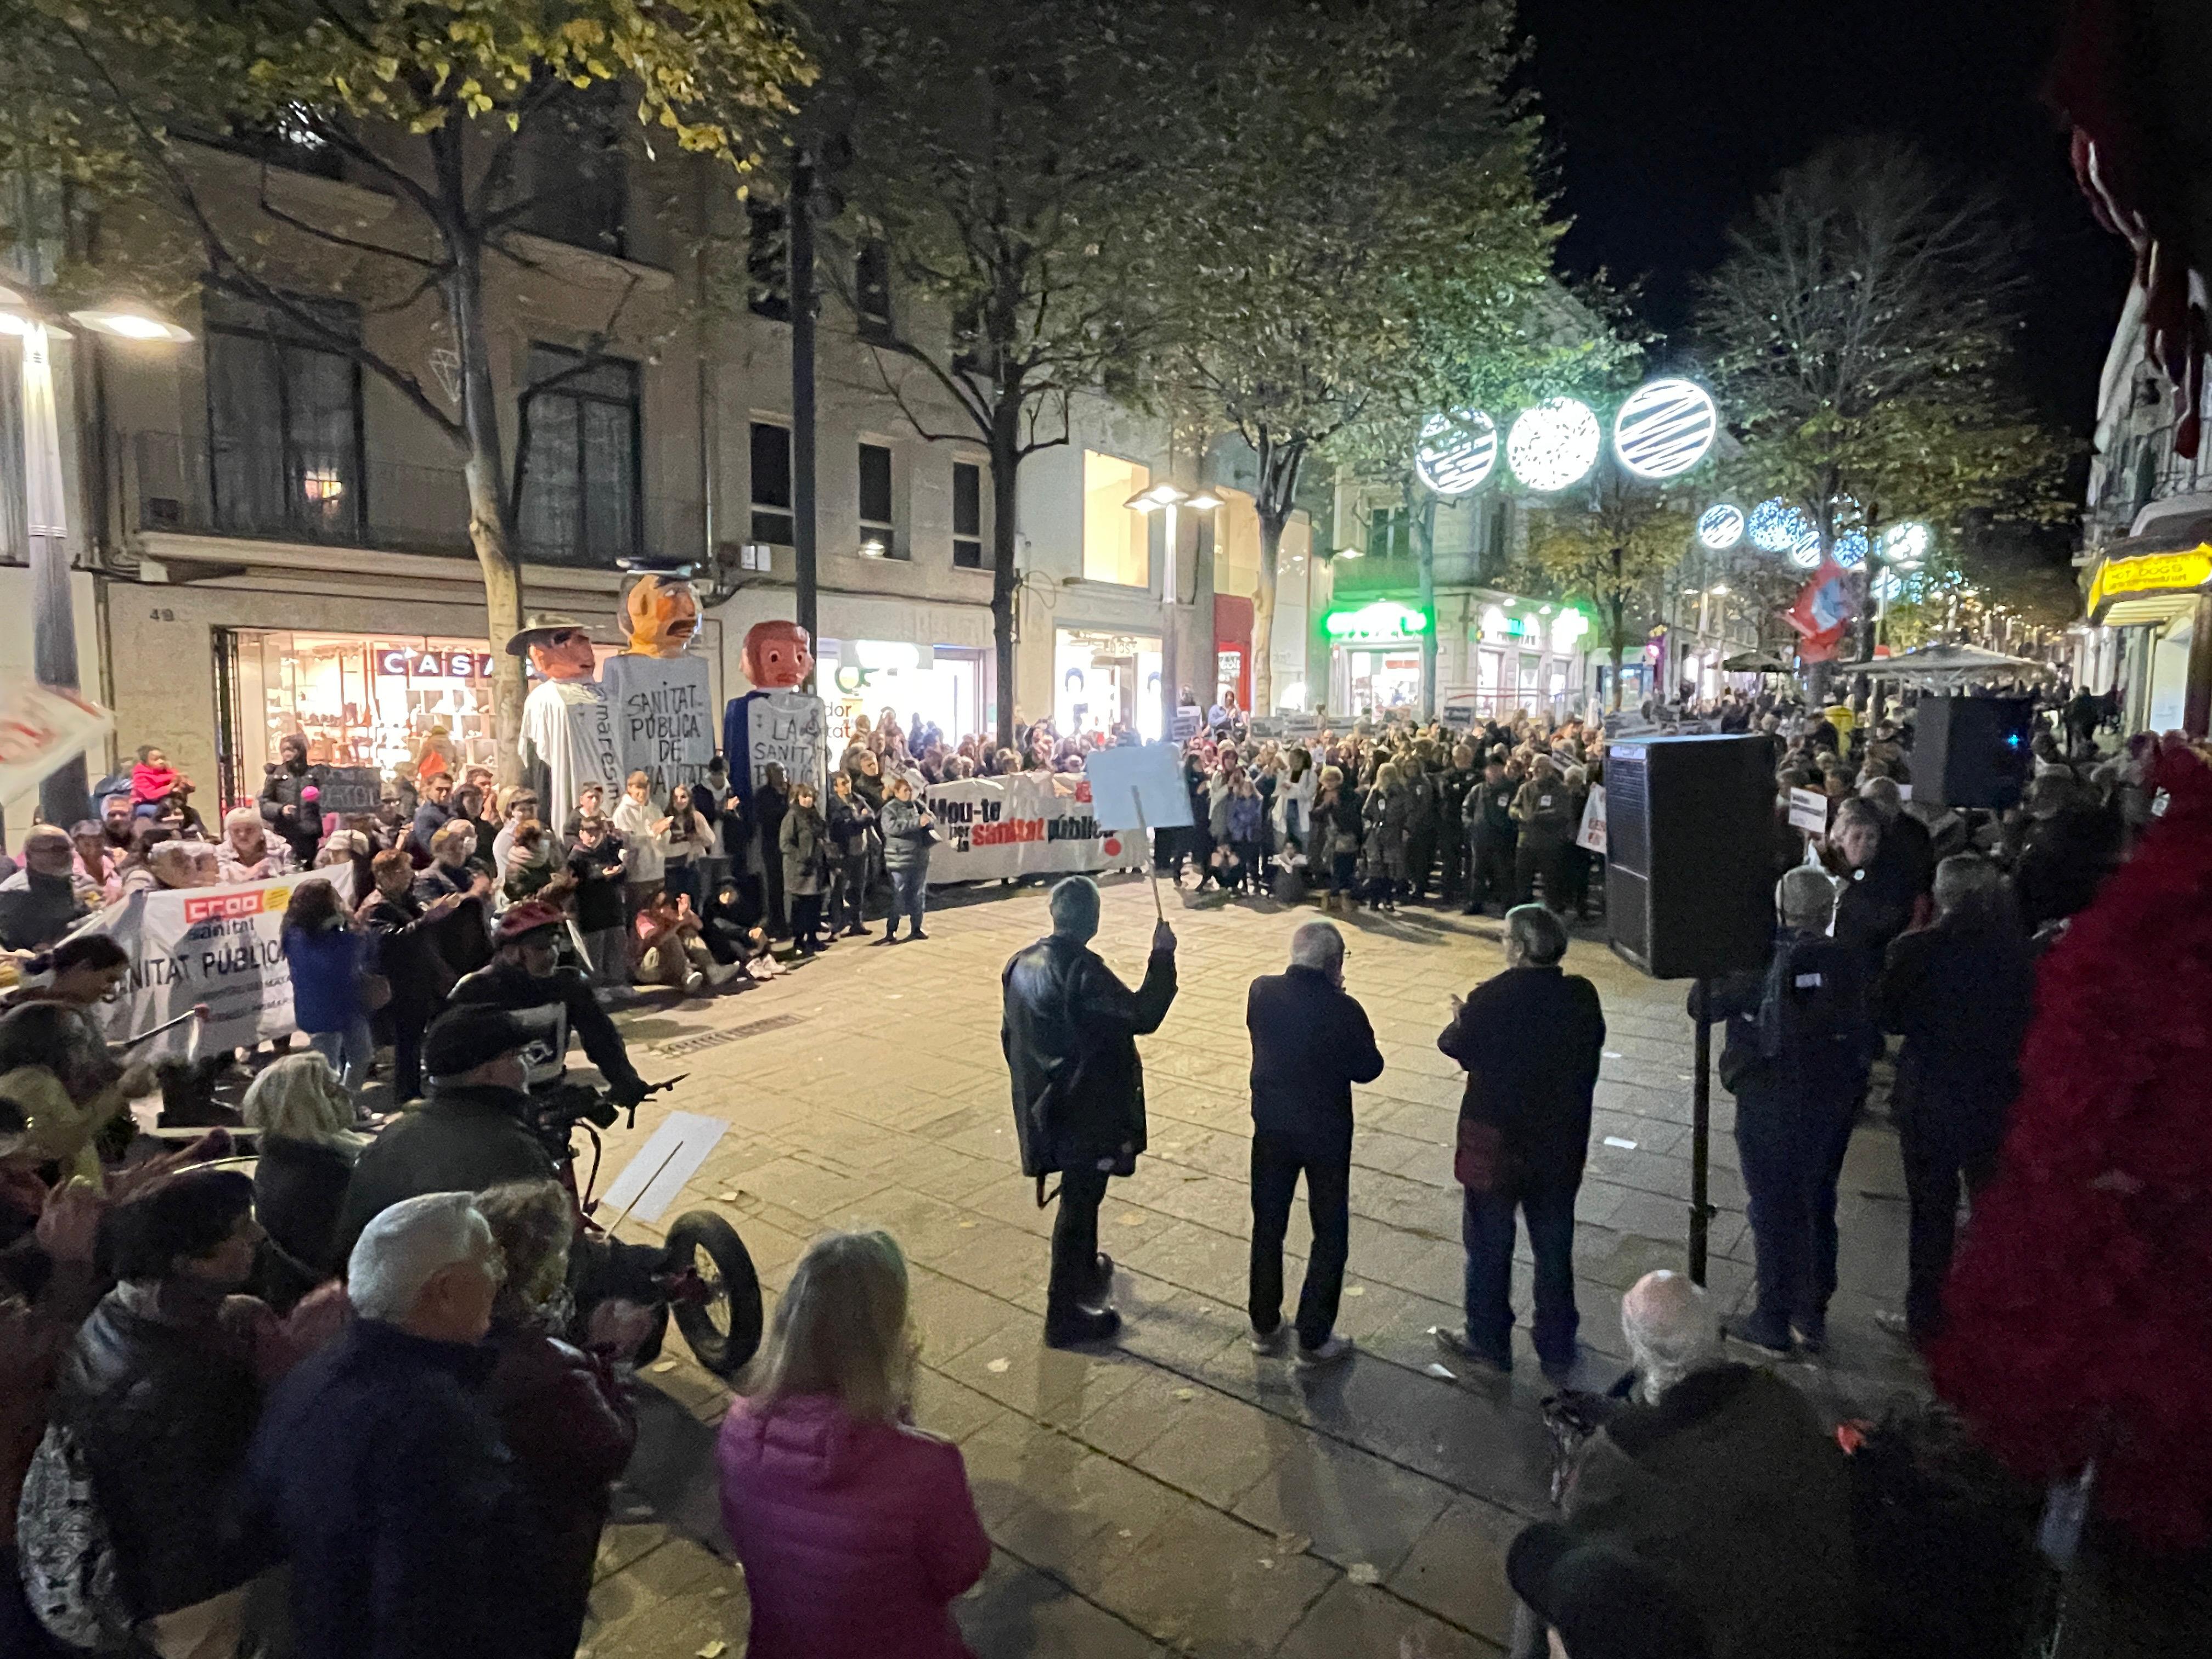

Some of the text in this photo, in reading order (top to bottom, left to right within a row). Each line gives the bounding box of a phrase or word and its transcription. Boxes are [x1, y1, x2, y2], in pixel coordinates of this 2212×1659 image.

[628, 681, 697, 716] SANITAT
[772, 716, 798, 742] LA
[658, 738, 682, 763] DE
[972, 817, 1045, 846] sanitat
